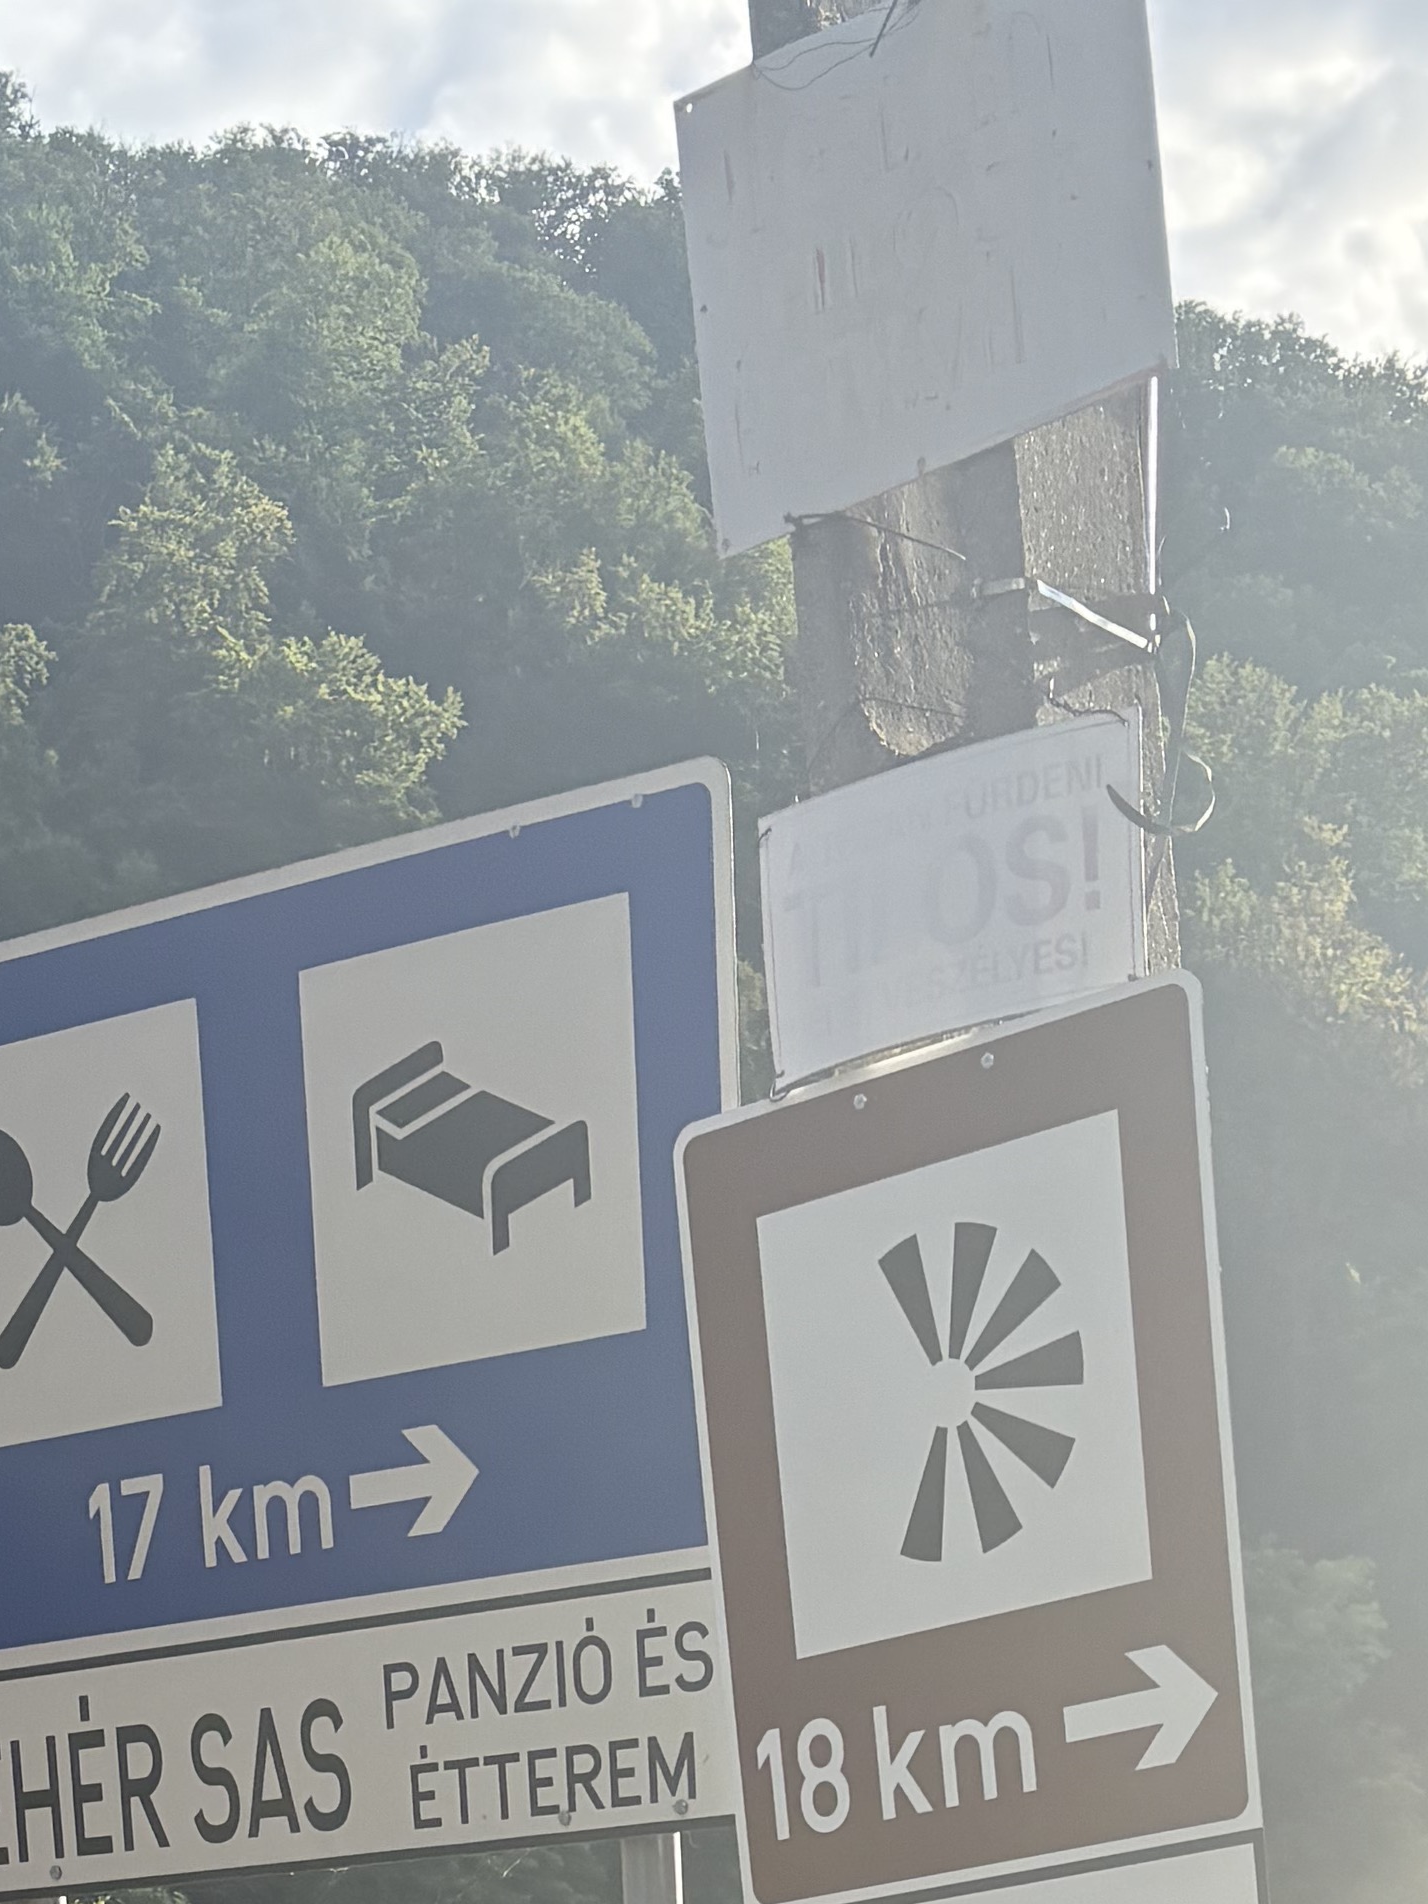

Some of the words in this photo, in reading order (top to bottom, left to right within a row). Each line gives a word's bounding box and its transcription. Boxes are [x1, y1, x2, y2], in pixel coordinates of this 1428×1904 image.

[87, 1473, 164, 1584] 17
[198, 1465, 335, 1568] km
[383, 1616, 613, 1730] PANZIÓ
[637, 1608, 714, 1698] ÉS
[191, 1698, 352, 1845] SAS
[409, 1731, 699, 1830] ÉTTEREM
[756, 1717, 850, 1841] 18
[872, 1705, 1039, 1820] km
